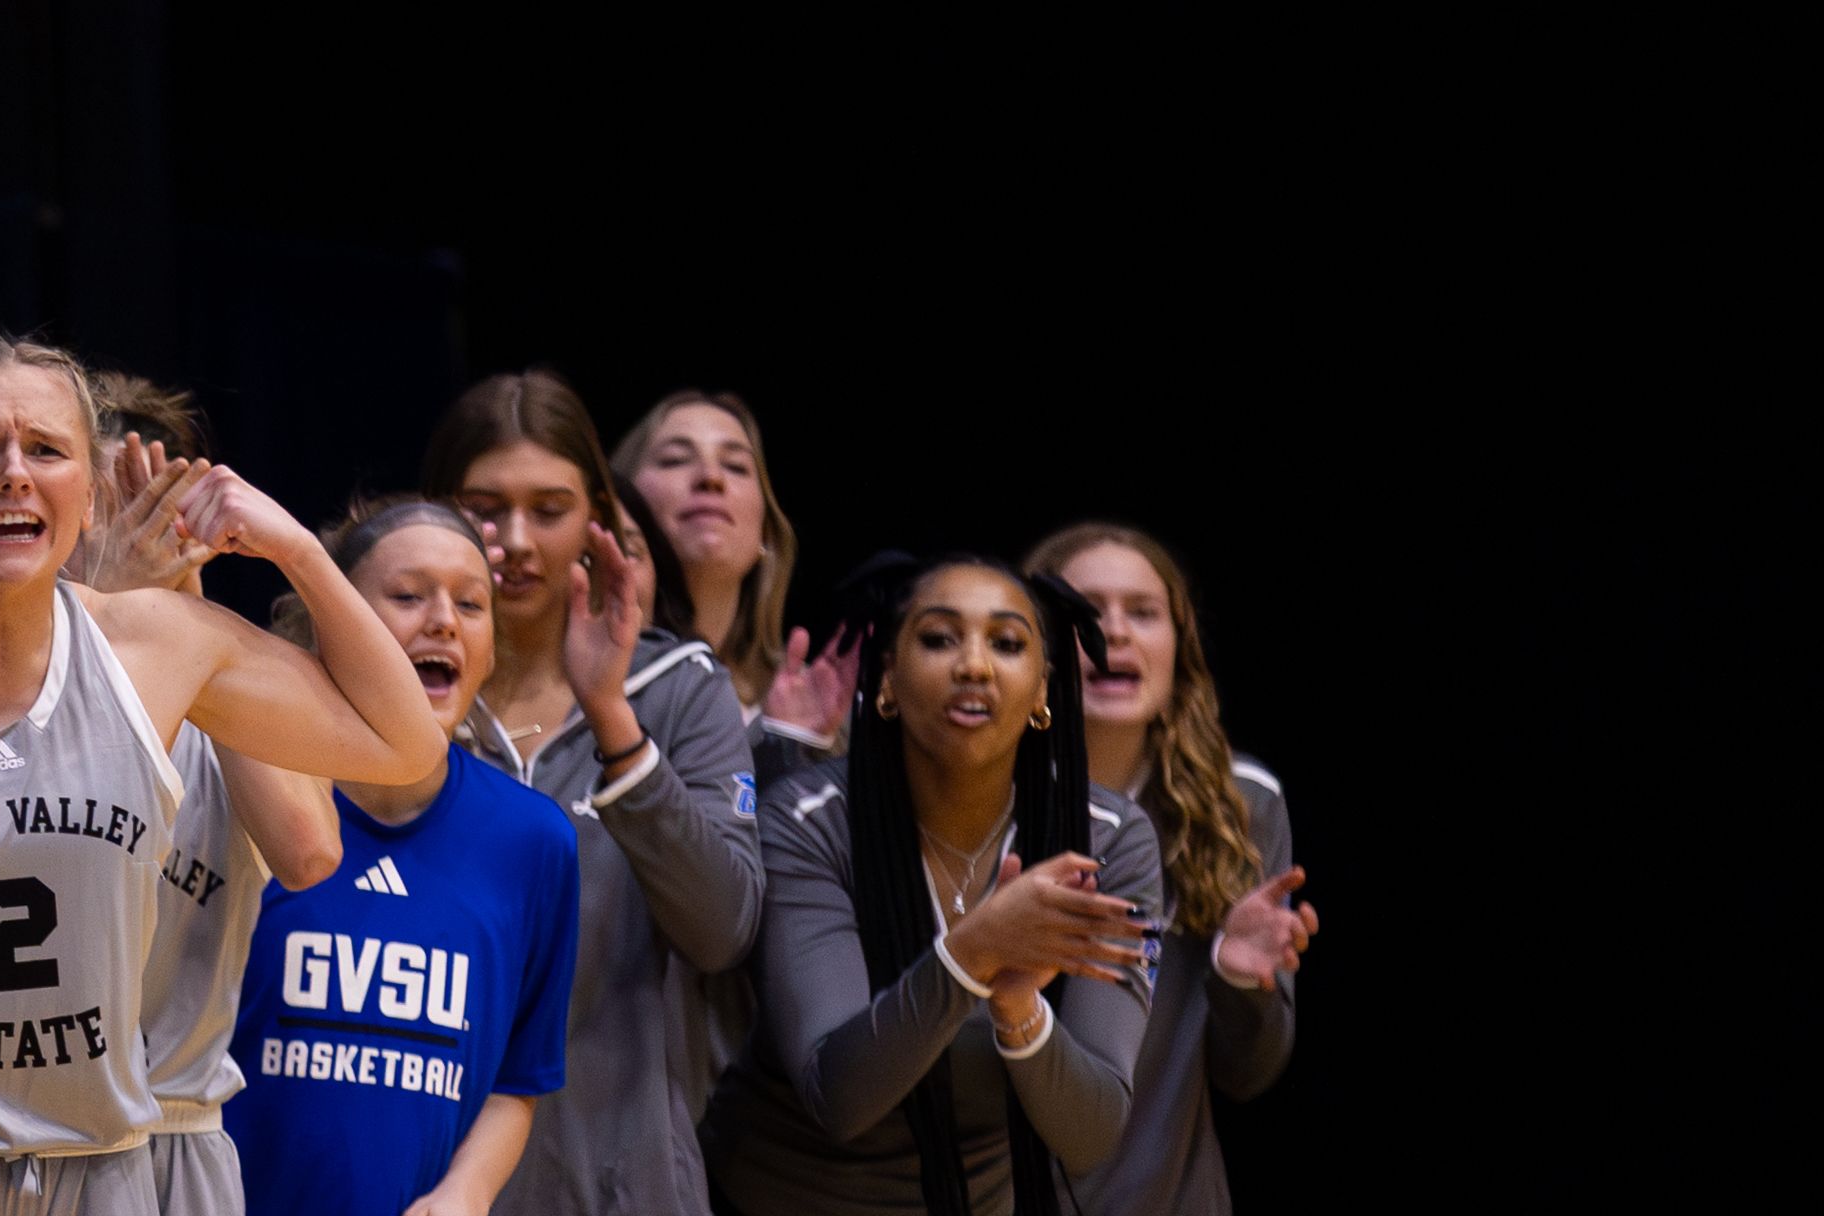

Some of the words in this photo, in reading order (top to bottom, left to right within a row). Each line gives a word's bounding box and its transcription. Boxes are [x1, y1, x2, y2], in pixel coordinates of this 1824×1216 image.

[6, 796, 147, 856] VALLEY
[282, 930, 469, 1031] GVSU
[261, 1037, 464, 1102] BASKETBALL
